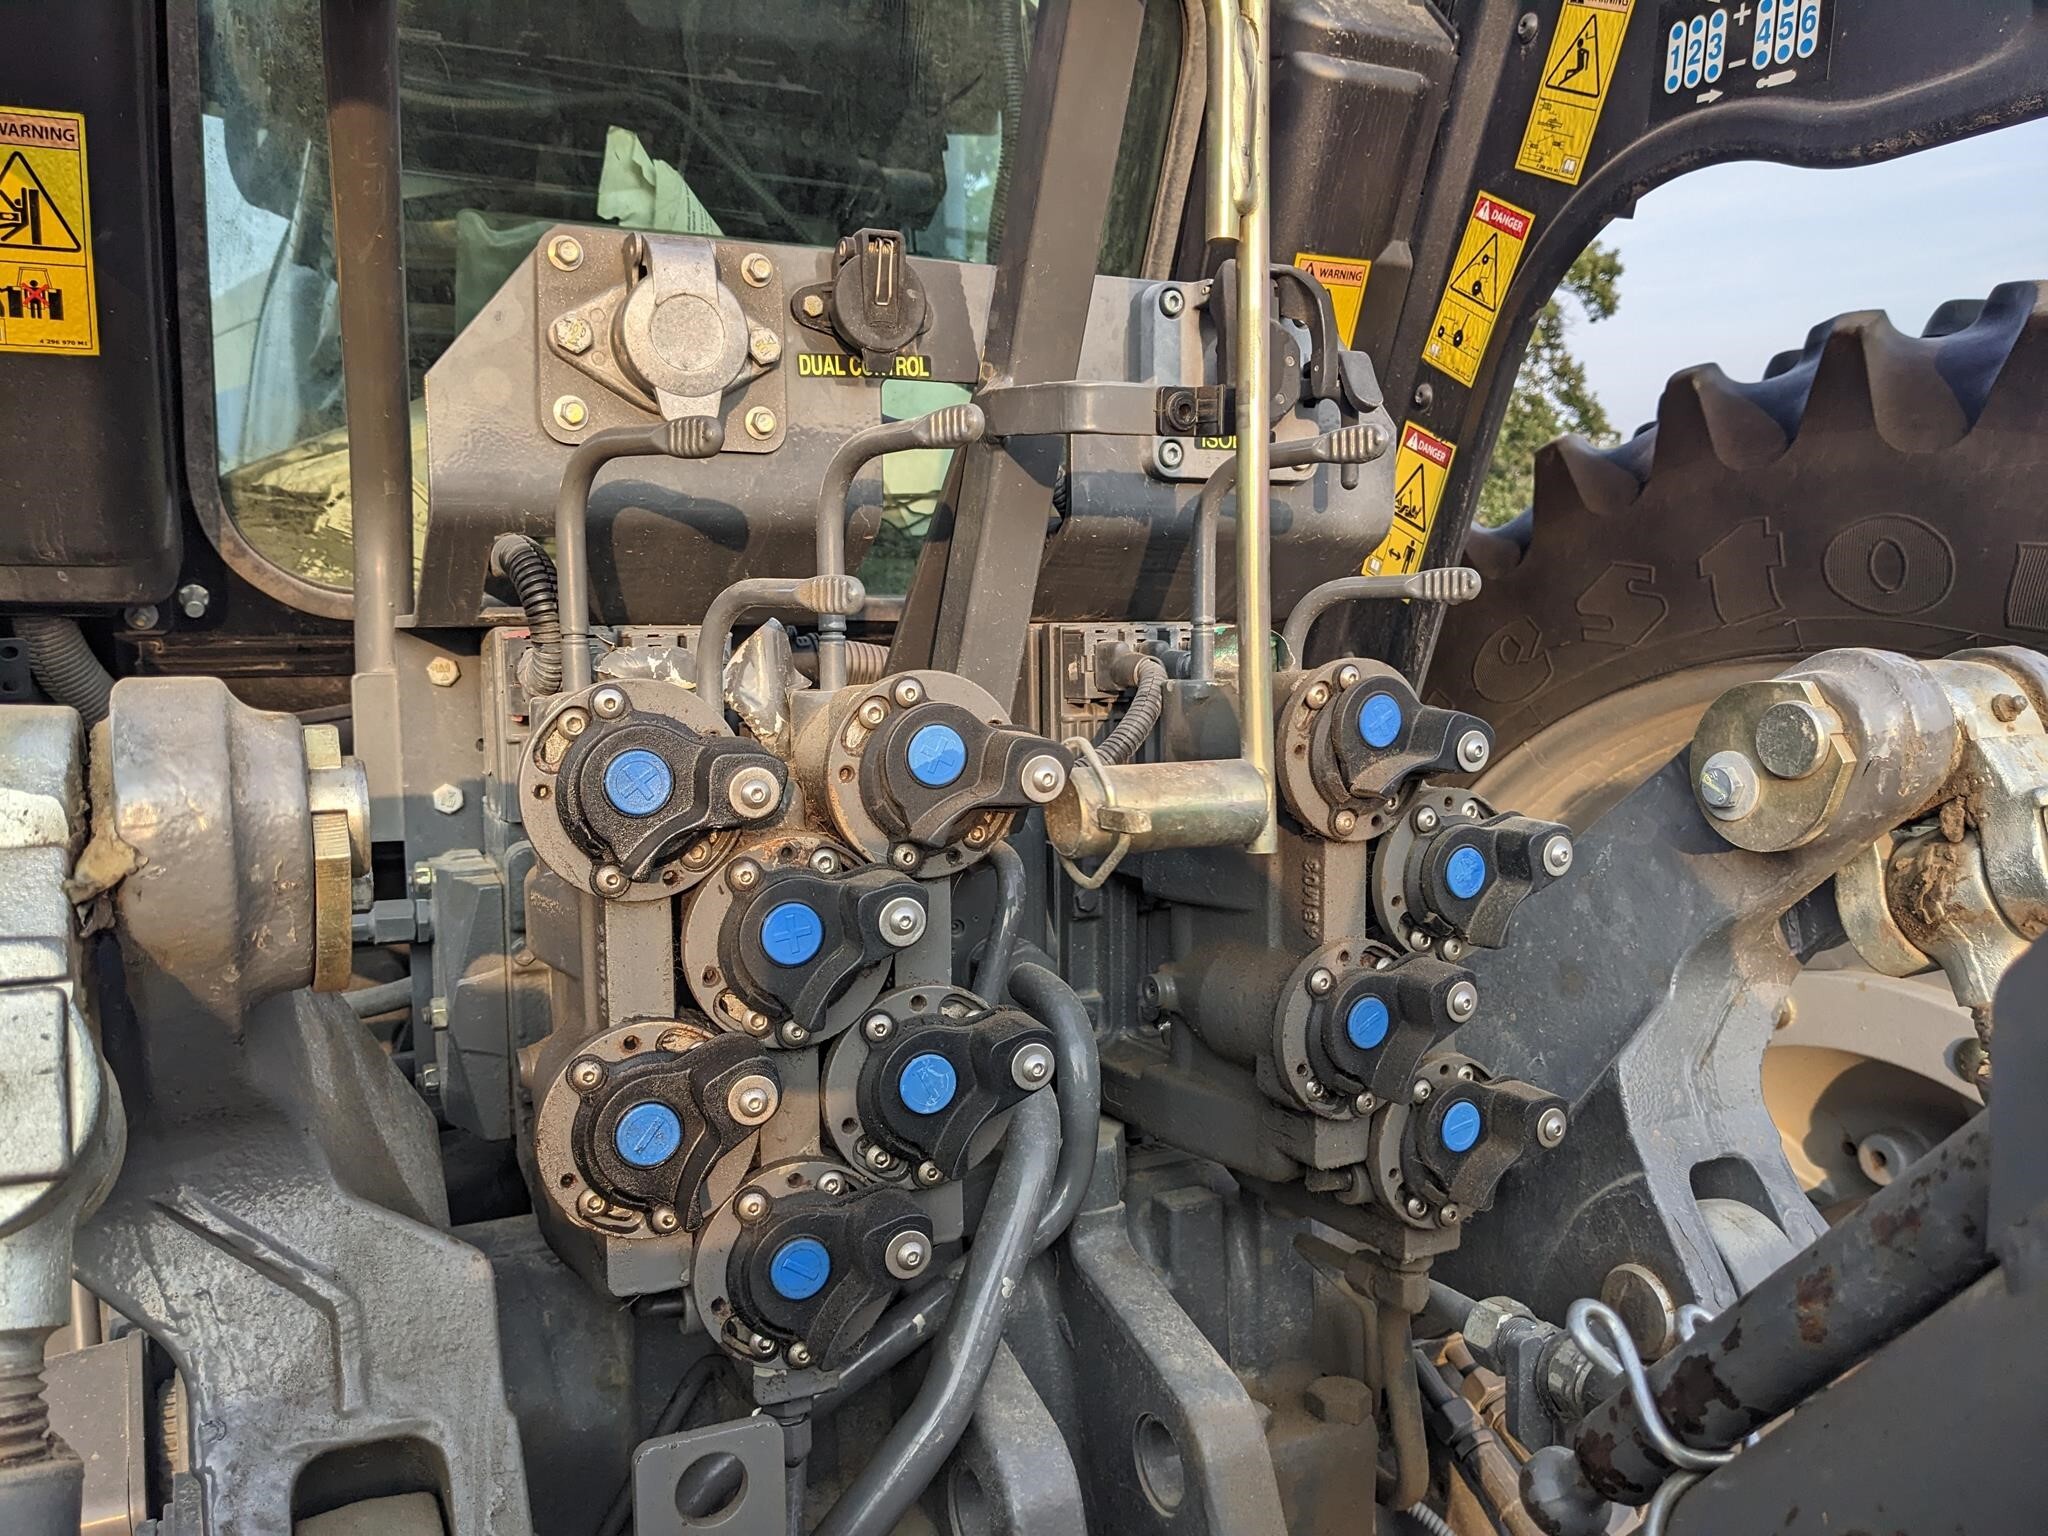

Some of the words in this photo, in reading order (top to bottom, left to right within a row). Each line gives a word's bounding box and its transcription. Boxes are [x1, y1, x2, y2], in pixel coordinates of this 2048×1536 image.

[1756, 19, 1771, 45] 4
[1778, 12, 1794, 40] 5
[1801, 5, 1817, 34] 6
[1670, 45, 1680, 70] 1
[1687, 39, 1702, 66] 2
[1708, 33, 1722, 60] 3
[1491, 210, 1524, 233] DANGER
[1320, 267, 1363, 281] WARNING
[799, 354, 846, 376] DUAL
[1418, 440, 1446, 463] DANGER
